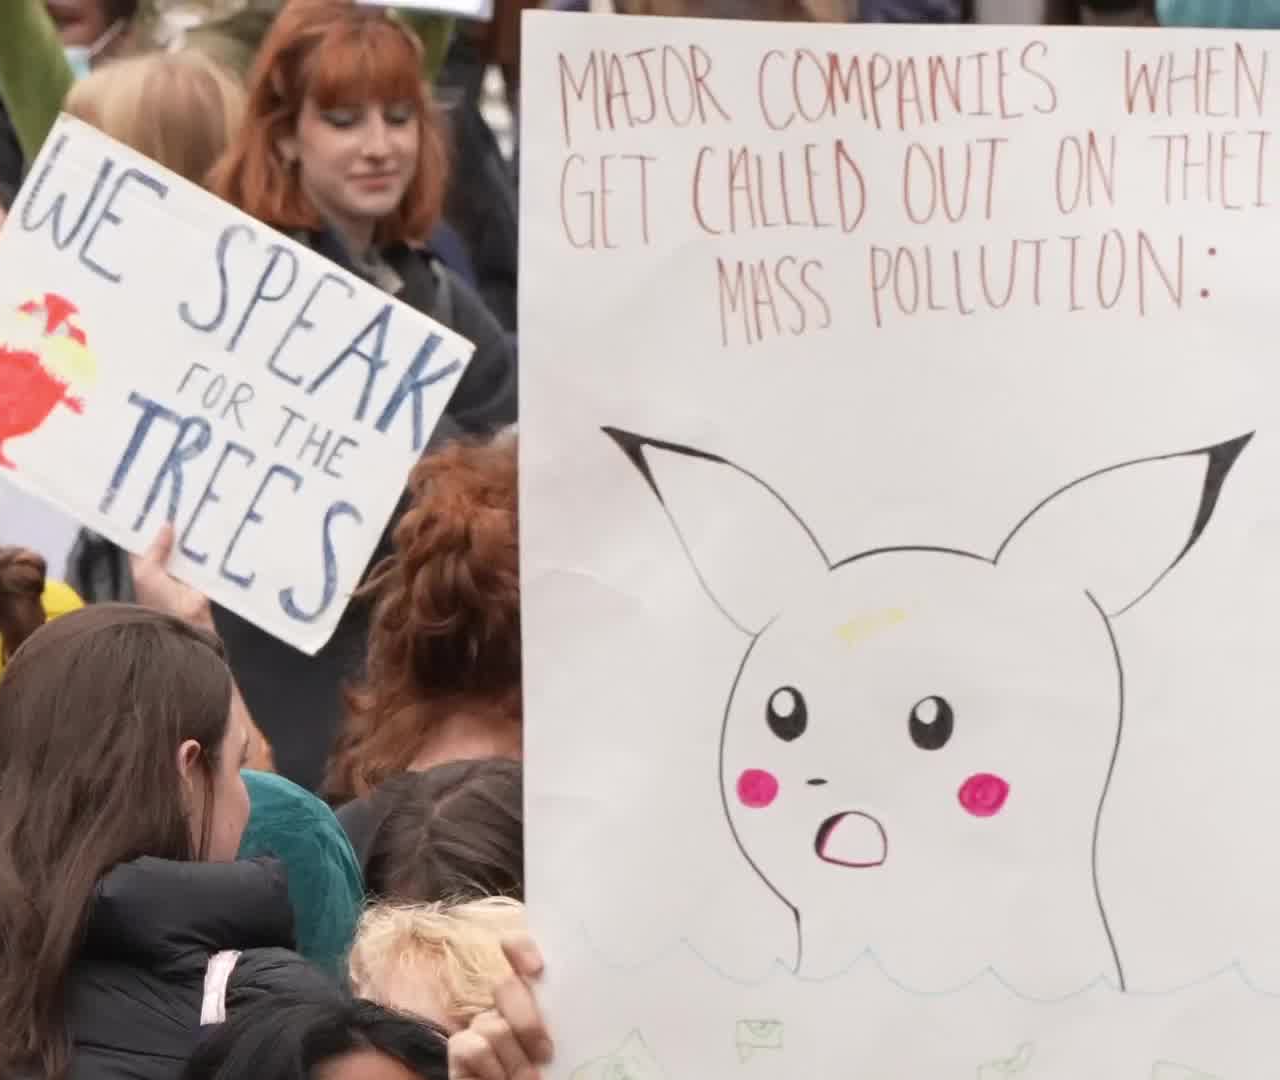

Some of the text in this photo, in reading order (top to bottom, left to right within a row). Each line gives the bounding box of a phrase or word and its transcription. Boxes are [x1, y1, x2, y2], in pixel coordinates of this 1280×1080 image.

[557, 40, 1268, 145] MAJOR COMPANIES WHEN
[559, 152, 657, 250] GET
[692, 139, 867, 235] CALLED
[903, 137, 1008, 225] OUT
[1056, 130, 1116, 215] ON
[21, 133, 460, 452] WE SPEAK
[717, 229, 1218, 348] MASS POLLUTION:
[176, 361, 361, 478] FOR THE
[98, 391, 363, 623] TREES
